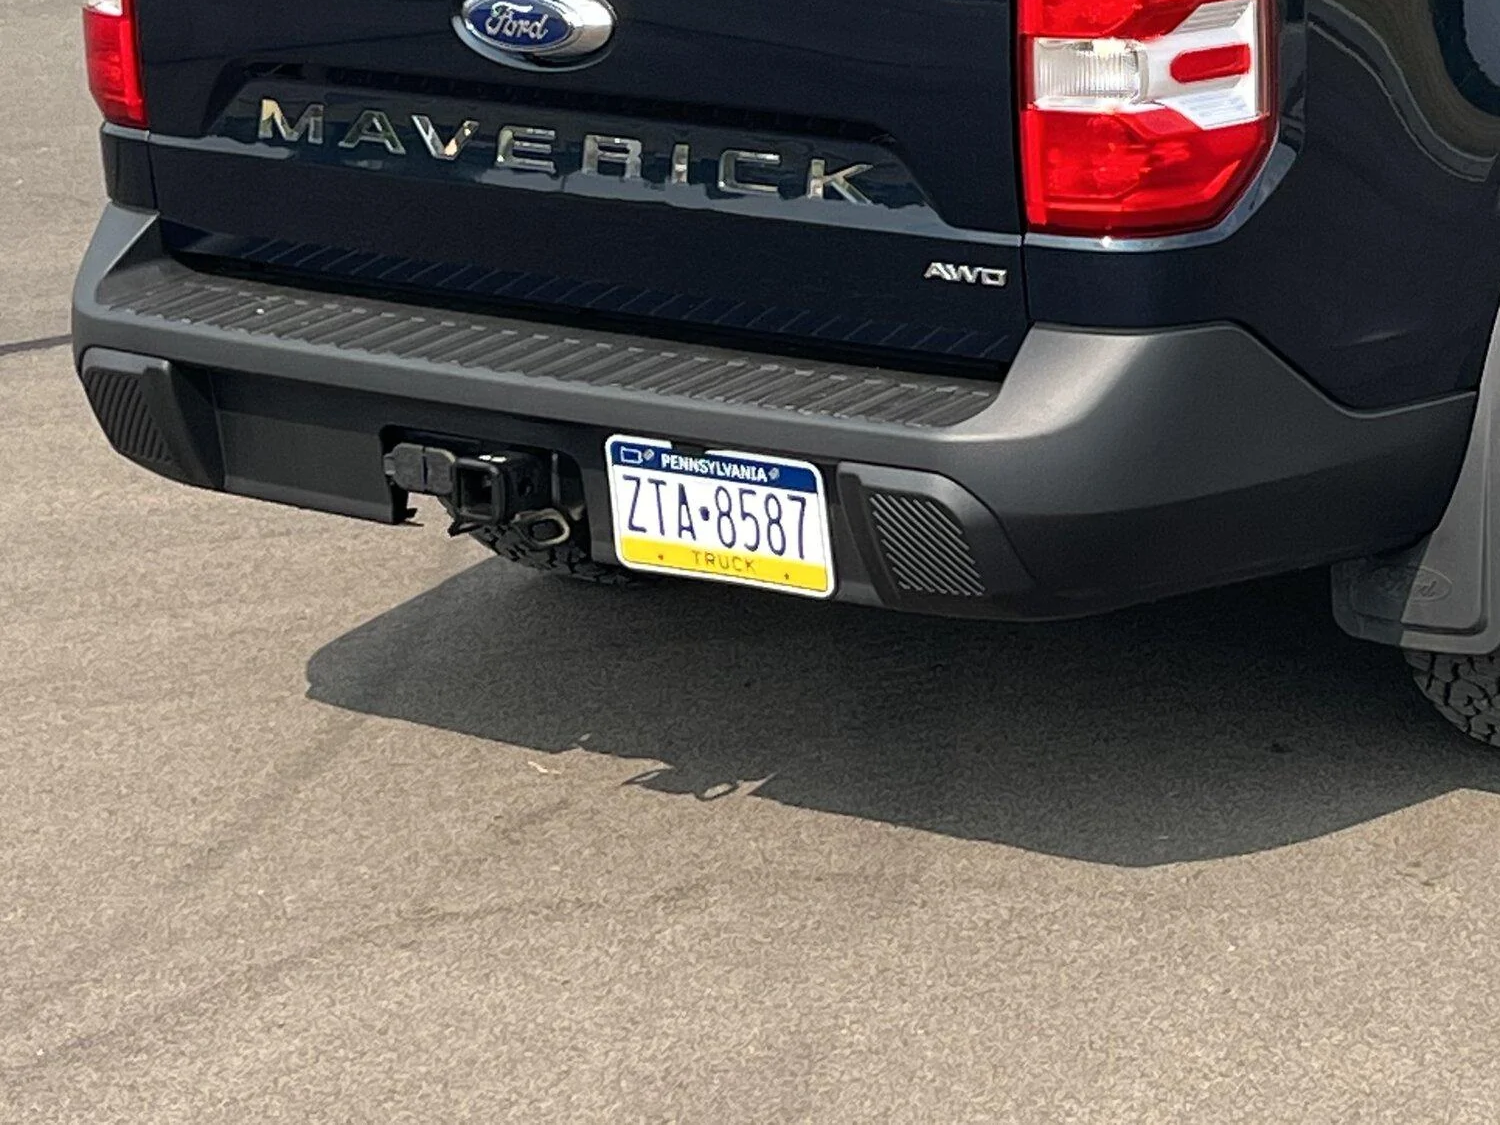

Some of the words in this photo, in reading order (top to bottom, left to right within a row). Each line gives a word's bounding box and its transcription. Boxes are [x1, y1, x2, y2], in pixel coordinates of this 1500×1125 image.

[484, 0, 550, 41] Ford
[257, 97, 876, 208] MAVERICK
[923, 262, 1008, 287] AWD
[660, 453, 769, 483] PENNSYLVANIA
[690, 549, 757, 574] TRUCK
